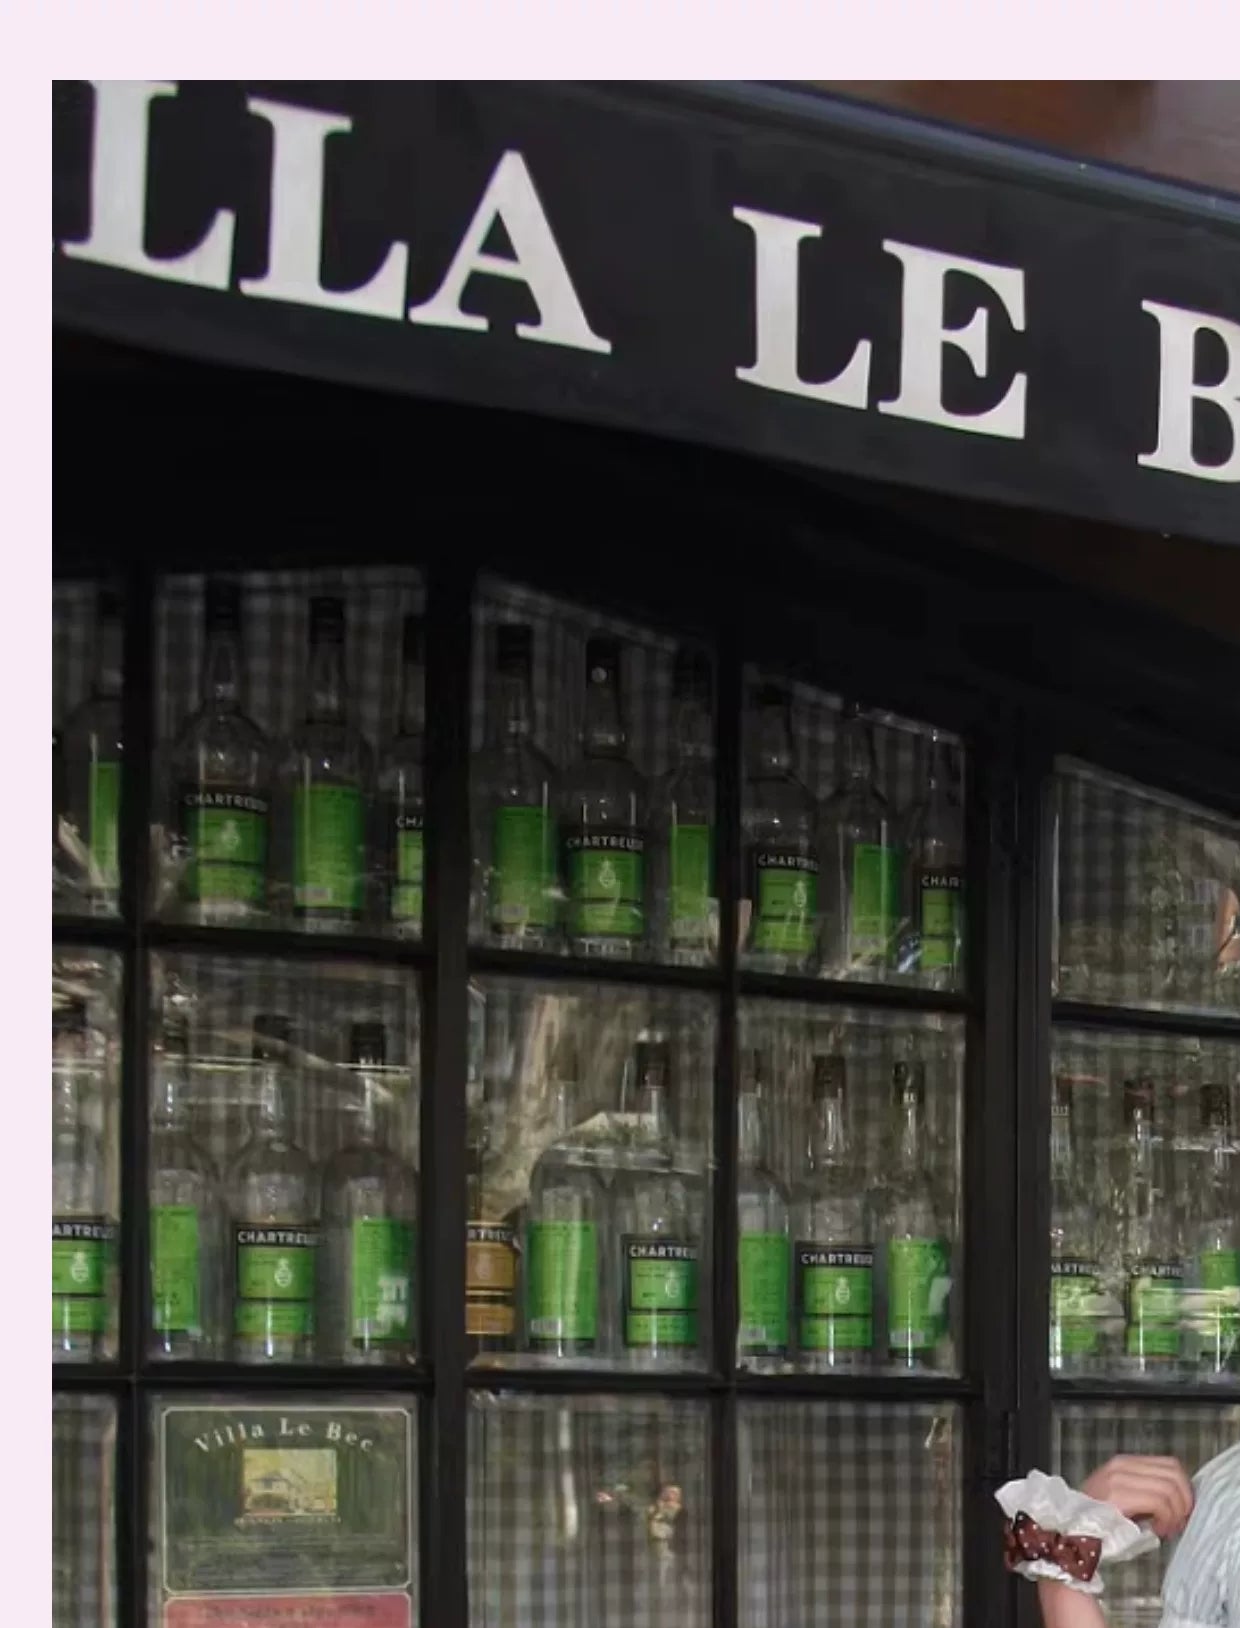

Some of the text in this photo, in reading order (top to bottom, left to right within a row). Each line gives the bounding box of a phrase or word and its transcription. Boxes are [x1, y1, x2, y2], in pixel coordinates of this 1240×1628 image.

[733, 206, 1028, 440] LE
[194, 1417, 374, 1453] Villa Le Bec
